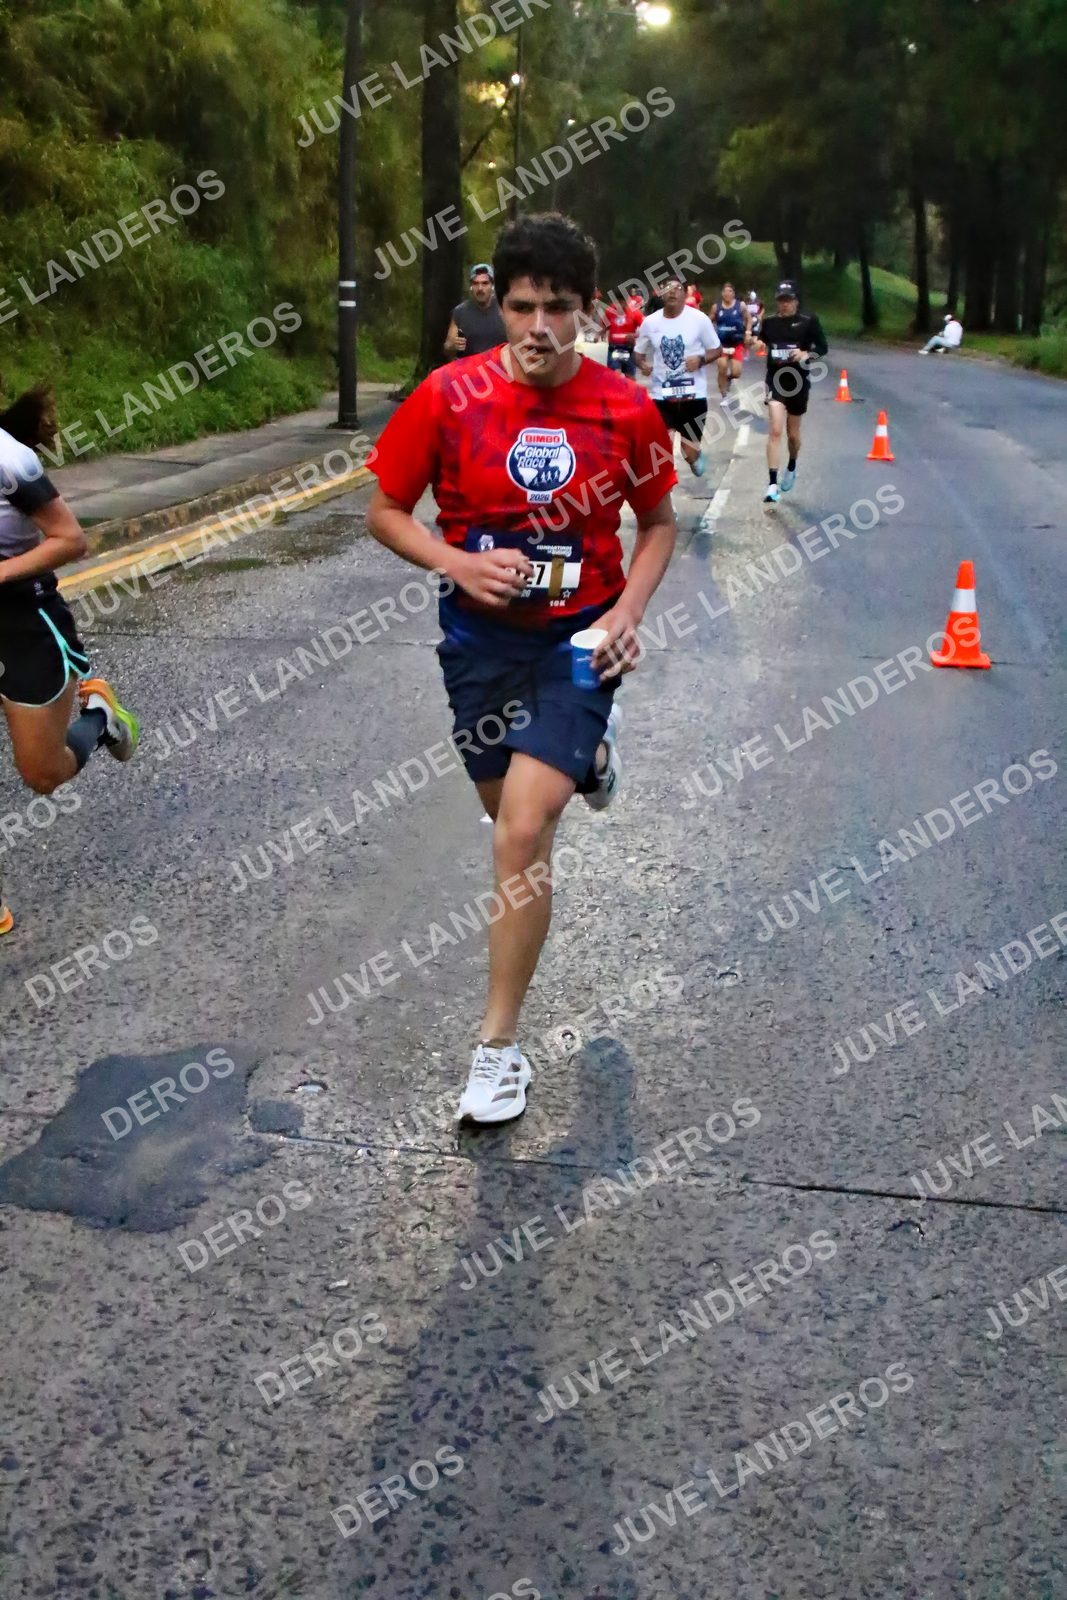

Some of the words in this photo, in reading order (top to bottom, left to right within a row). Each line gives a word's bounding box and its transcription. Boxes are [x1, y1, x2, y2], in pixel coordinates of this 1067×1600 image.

[525, 435, 560, 443] BIMBO
[525, 446, 560, 459] Global
[517, 456, 546, 469] Race
